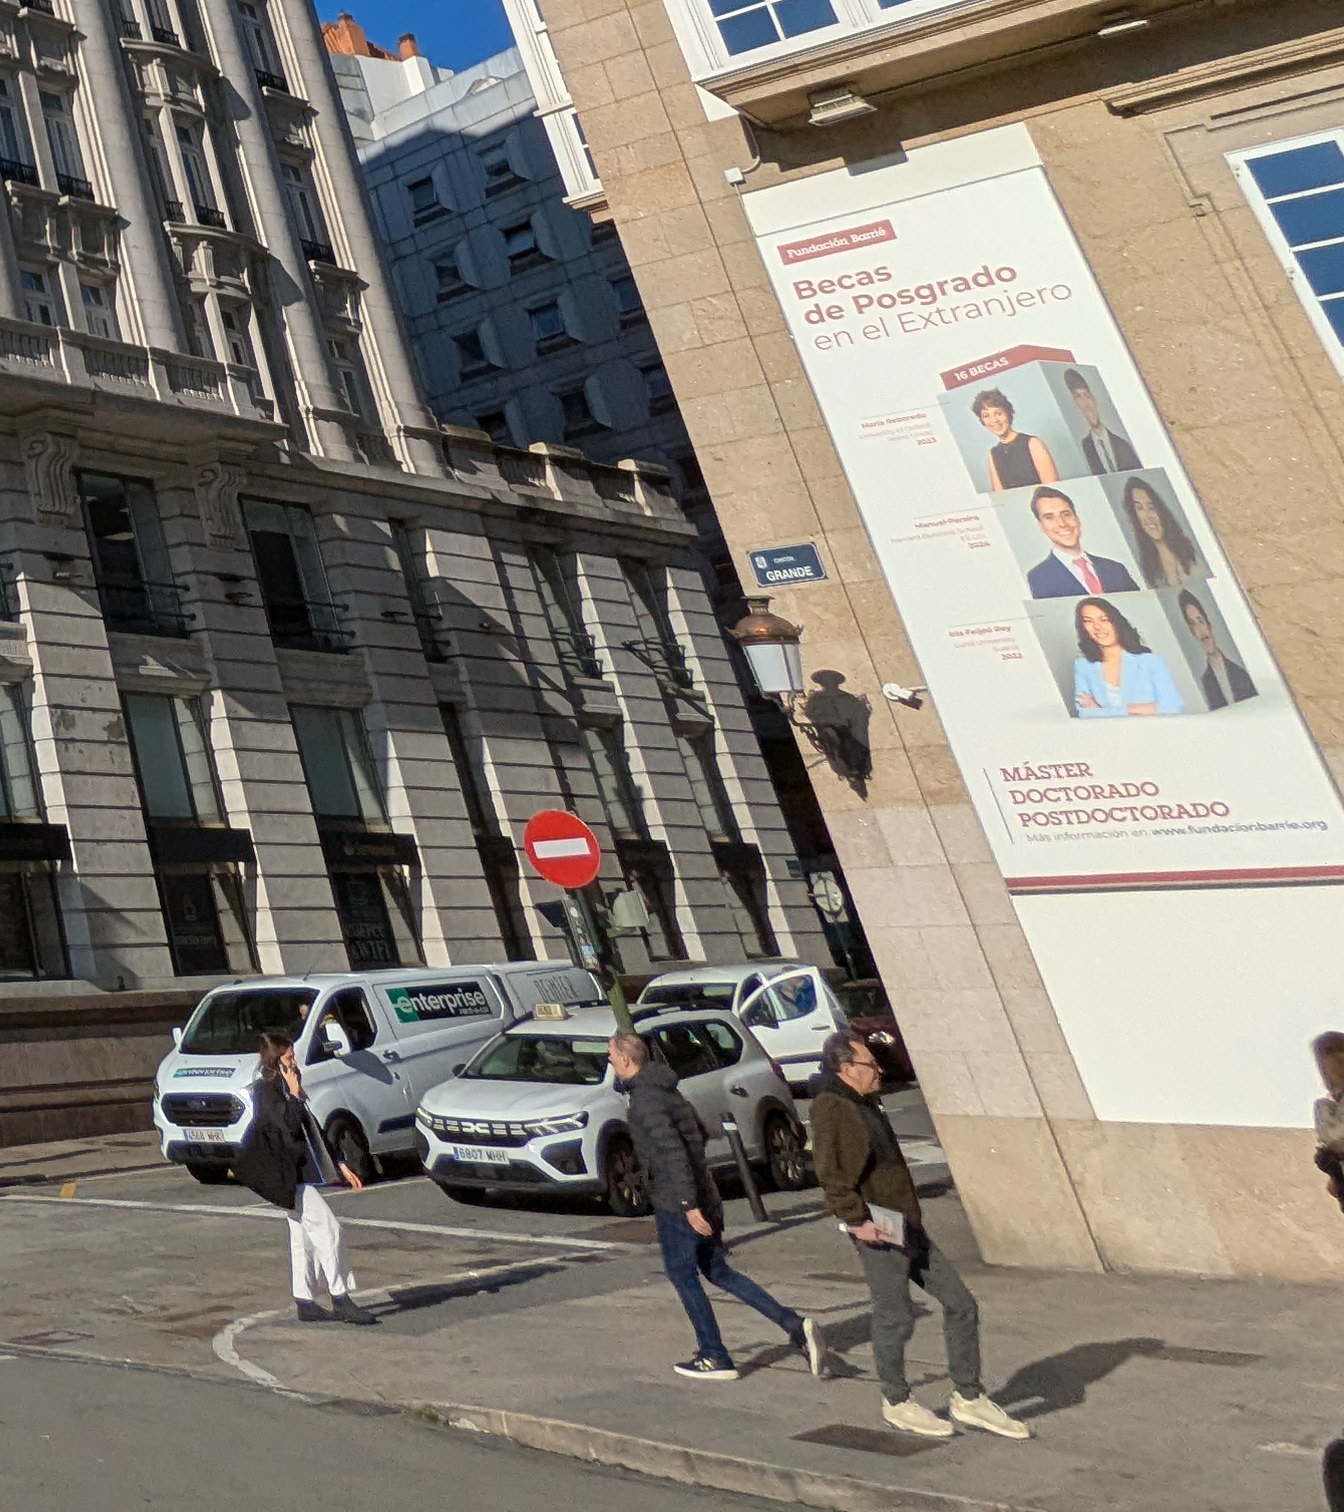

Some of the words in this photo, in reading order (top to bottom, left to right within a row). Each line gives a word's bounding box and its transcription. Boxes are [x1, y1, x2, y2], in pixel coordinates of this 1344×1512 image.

[787, 236, 848, 259] Fundación
[851, 226, 887, 244] Barrié
[792, 266, 893, 301] Becas
[804, 303, 846, 325] de
[851, 265, 1018, 315] Posgrado
[814, 330, 854, 350] en
[862, 317, 890, 340] el
[897, 283, 1072, 333] Extranjero
[954, 371, 968, 381] 16
[968, 357, 1009, 377] BECAS
[766, 566, 814, 582] GRANDE
[999, 762, 1093, 782] MÁSTER
[1009, 781, 1160, 805] DOCTORADO
[1017, 802, 1231, 828] POSTDOCTORADO
[395, 988, 486, 1014] enterprise
